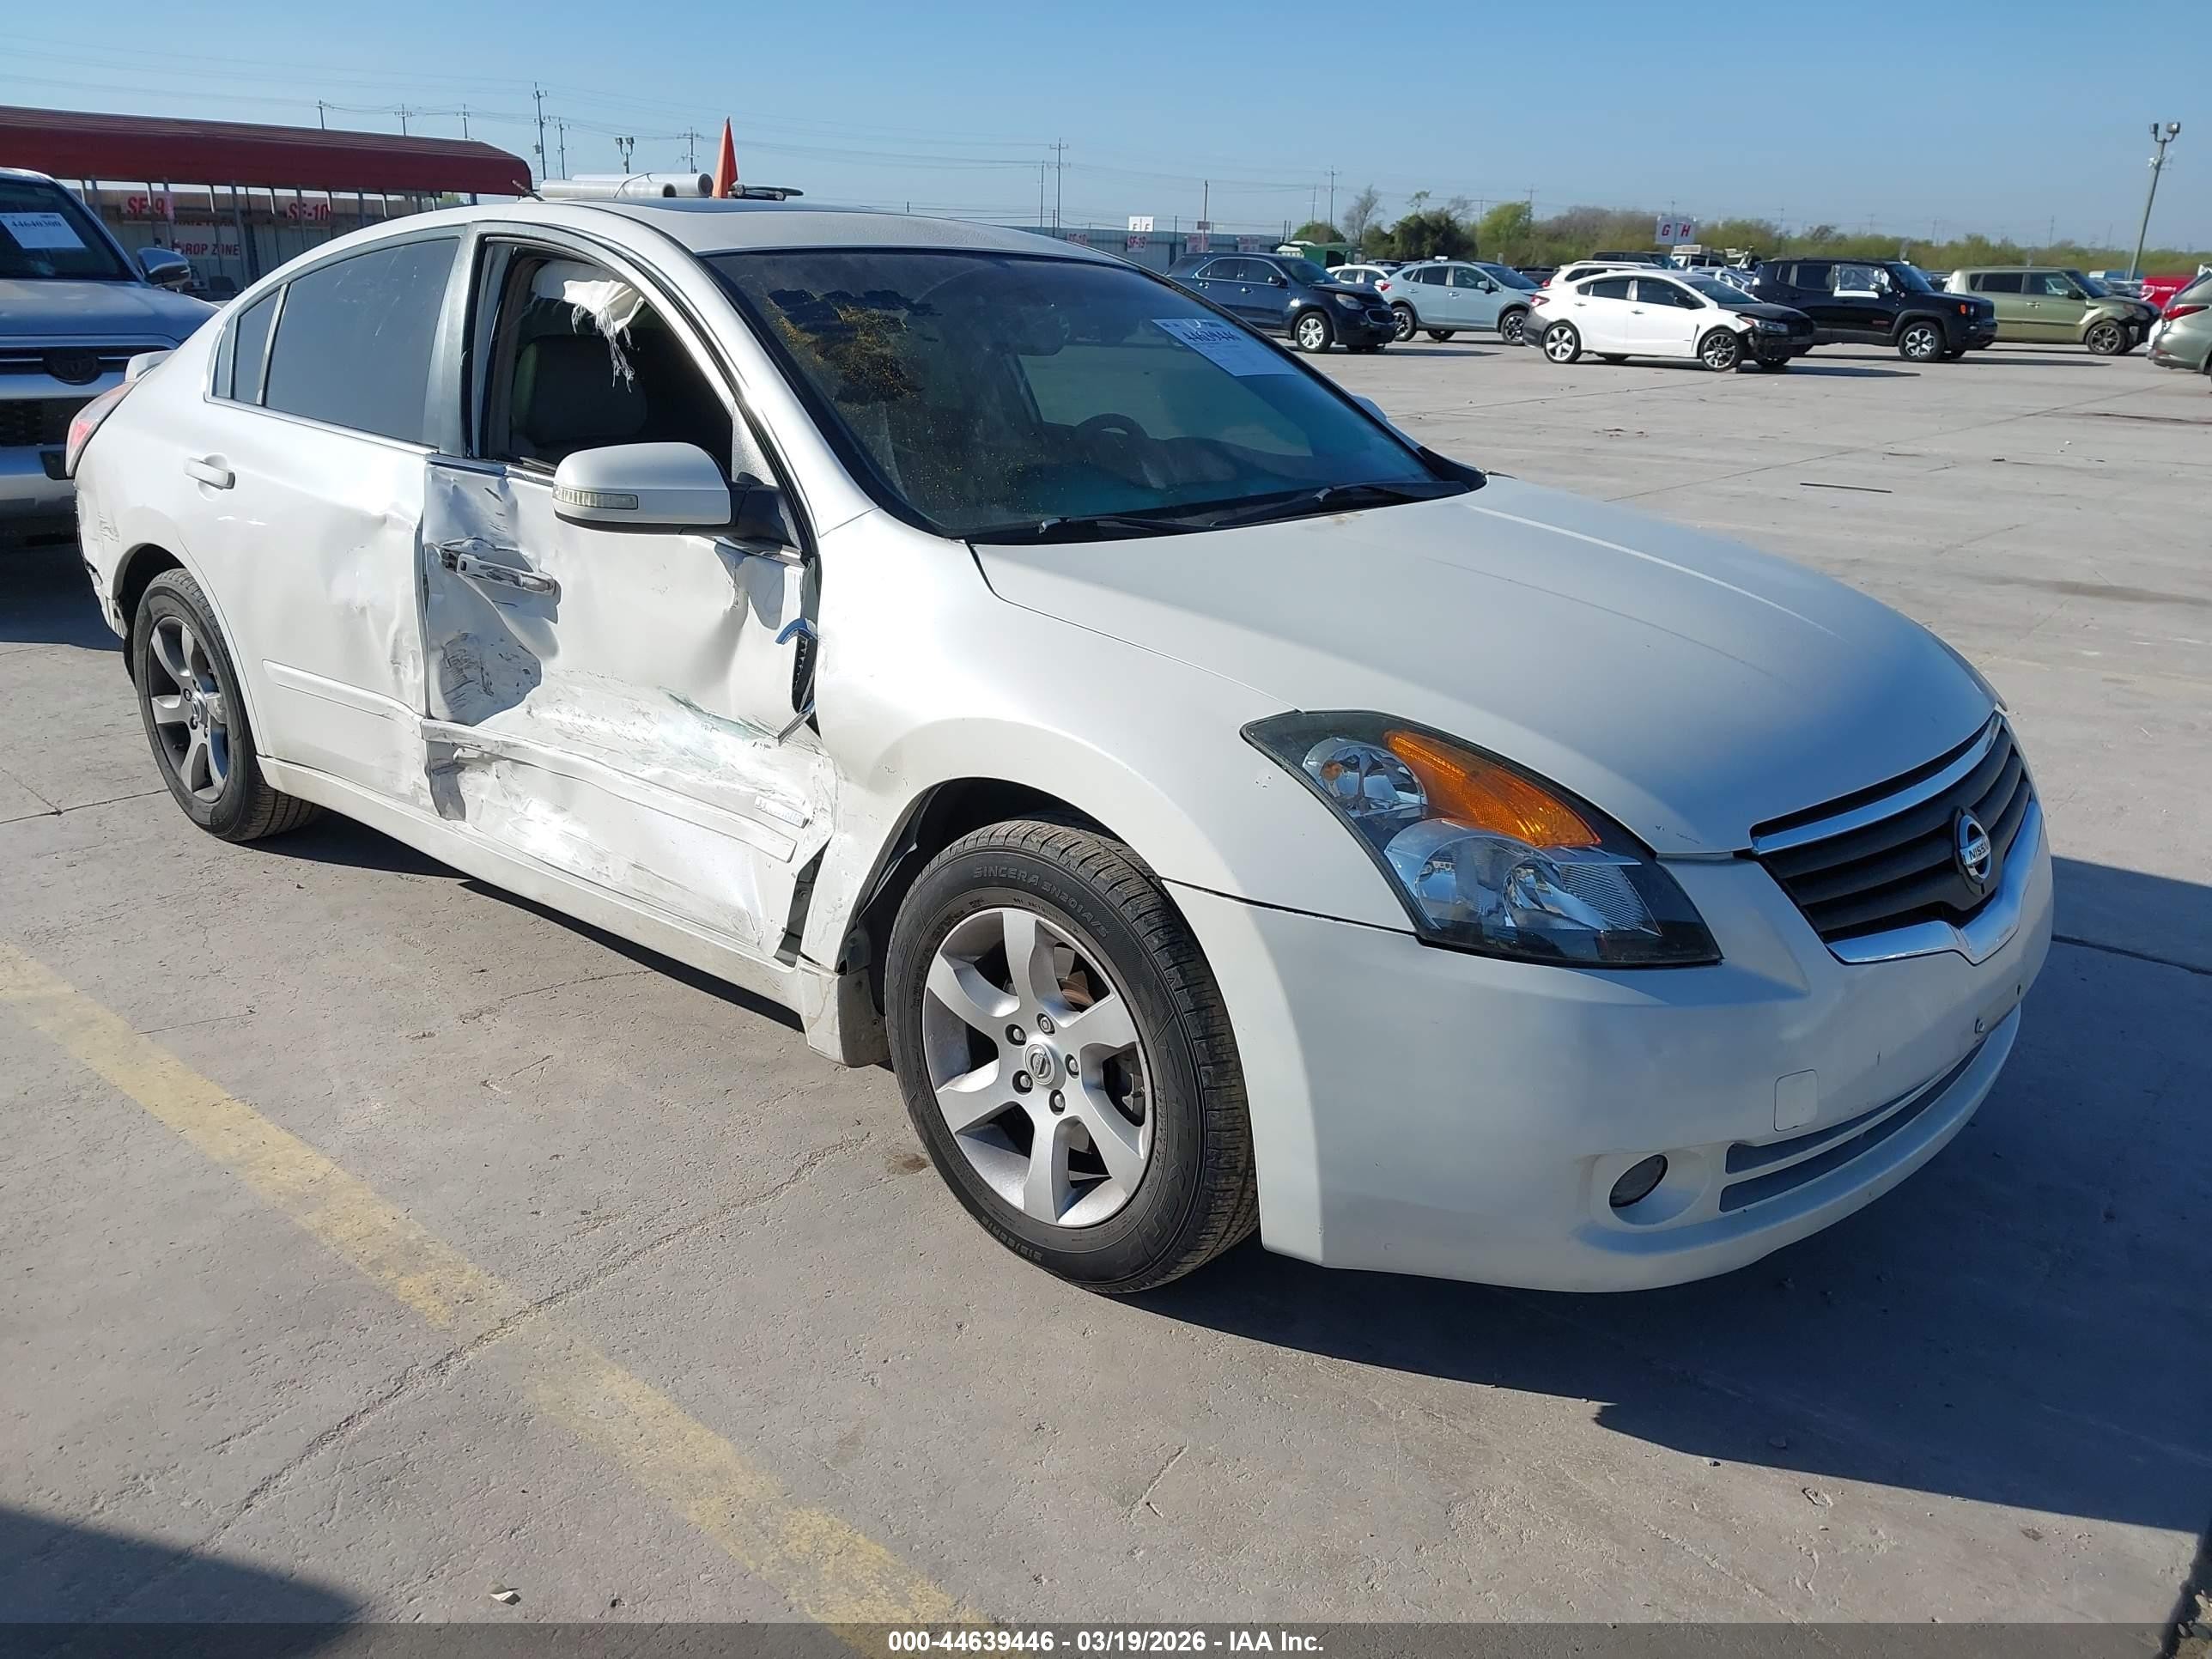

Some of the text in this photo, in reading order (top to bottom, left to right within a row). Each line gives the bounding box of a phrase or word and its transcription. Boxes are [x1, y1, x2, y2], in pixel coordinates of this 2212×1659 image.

[127, 196, 165, 215] SF9
[1662, 224, 1691, 237] G H
[973, 865, 1039, 886] SINCERA
